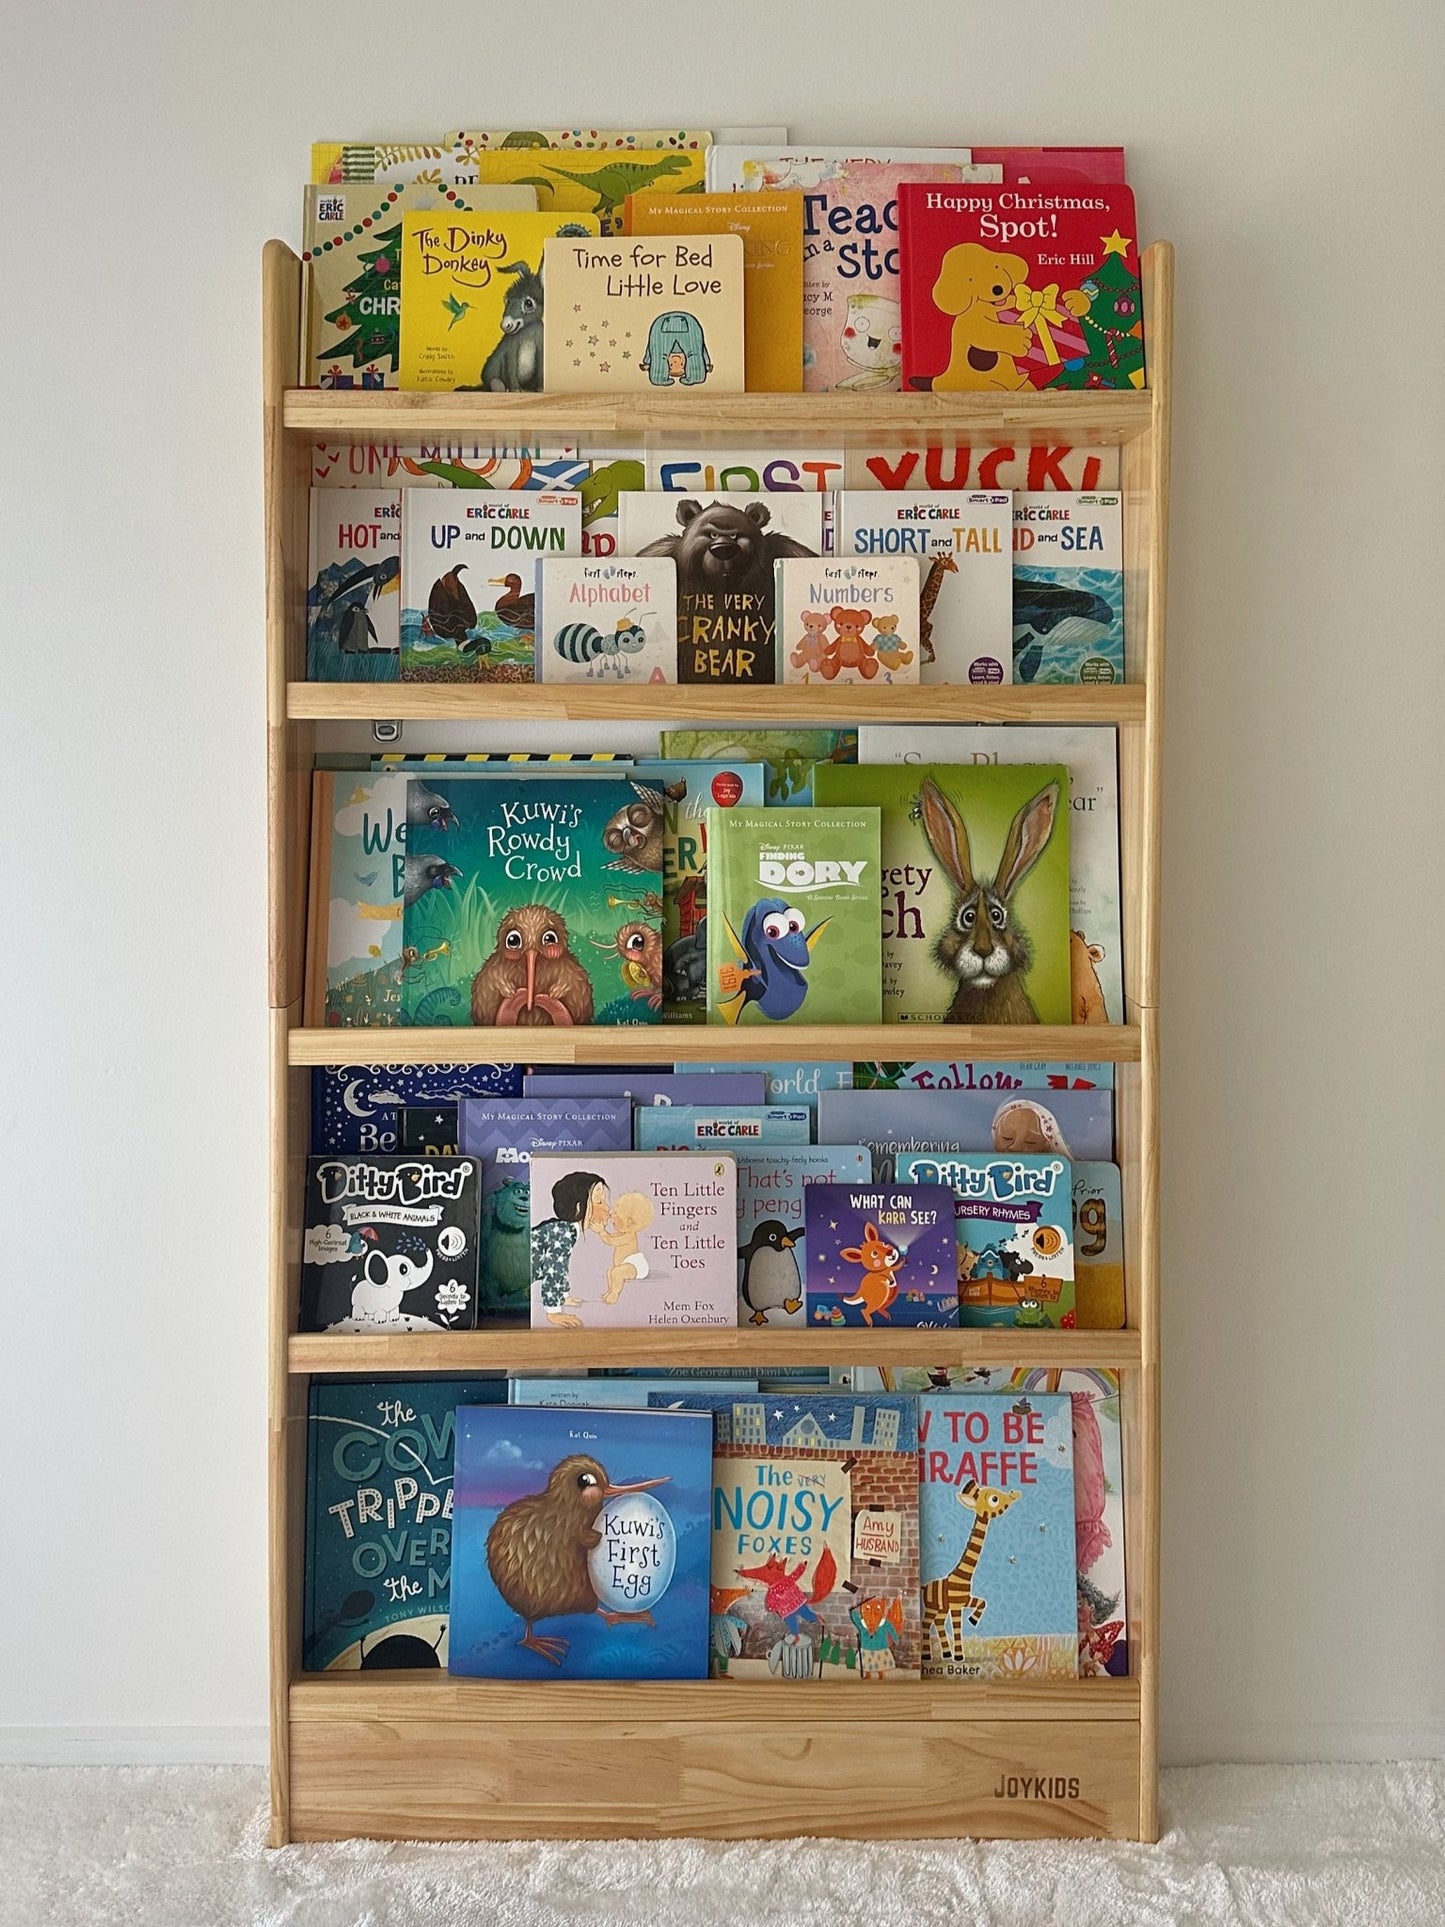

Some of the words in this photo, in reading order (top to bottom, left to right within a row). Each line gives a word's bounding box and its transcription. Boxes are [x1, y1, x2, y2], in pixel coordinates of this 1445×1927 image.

[320, 199, 343, 212] ERIC
[665, 206, 701, 214] MAGICAL
[705, 205, 731, 213] STORY
[735, 204, 787, 213] COLLECTION
[926, 193, 993, 212] Happy
[999, 193, 1110, 213] Christmas,
[319, 212, 344, 220] CARLE
[980, 214, 1058, 243] Spot!
[412, 228, 439, 253] The
[444, 227, 507, 259] Dinky
[572, 248, 622, 269] Time
[630, 244, 666, 268] for
[676, 244, 712, 268] Bed
[1038, 254, 1066, 265] Eric
[1070, 254, 1095, 265] Hill
[422, 253, 491, 288] Donkey
[607, 274, 663, 297] Little
[673, 274, 722, 295] Love
[467, 504, 496, 519] ERIC
[500, 508, 530, 519] CARLE
[898, 505, 926, 519] ERIC
[928, 508, 960, 519] CARLE
[1038, 510, 1070, 521] CARLE
[338, 524, 382, 549] HOT
[431, 525, 460, 549] UP
[465, 532, 485, 541] and
[491, 525, 565, 551] DOWN
[855, 528, 931, 554] SHORT
[931, 537, 952, 547] and
[952, 528, 1002, 553] TALL
[1038, 534, 1058, 542] and
[1061, 526, 1104, 551] SEA
[584, 567, 601, 578] first
[825, 567, 841, 578] first
[569, 582, 652, 607] Alphabet
[810, 583, 894, 604] Numbers
[683, 594, 714, 611] THE
[725, 594, 765, 611] VERY
[694, 648, 755, 678] BEAR
[500, 802, 582, 828] Kuwi's
[730, 820, 742, 828] MY
[745, 820, 782, 828] MAGICAL
[785, 820, 811, 828] STORY
[814, 820, 866, 828] COLLECTION
[487, 823, 569, 861] Rowdy
[760, 852, 805, 861] FINDING
[505, 850, 582, 882] Crowd
[760, 861, 868, 886] DORY
[767, 1068, 821, 1095] orld
[482, 1113, 495, 1121] MY
[498, 1113, 534, 1121] MAGICAL
[697, 1122, 725, 1136] ERIC
[728, 1125, 759, 1136] CARLE
[558, 1139, 583, 1147] PIXAR
[809, 1155, 829, 1163] books
[318, 1164, 395, 1202] Ditty
[396, 1164, 464, 1202] Bird
[650, 1182, 678, 1197] Ten
[685, 1181, 725, 1196] Little
[987, 1163, 1054, 1199] Bird
[850, 1194, 884, 1209] WHAT
[890, 1194, 912, 1209] CAN
[350, 1212, 371, 1220] BLACK
[379, 1212, 401, 1220] WHITE
[403, 1213, 435, 1222] ANIMALS
[661, 1202, 717, 1219] Fingers
[878, 1210, 906, 1225] KARA
[911, 1210, 937, 1225] SEE?
[993, 1207, 1030, 1220] RHYMES
[325, 1229, 331, 1239] 6
[680, 1221, 700, 1231] and
[651, 1235, 679, 1249] Ten
[685, 1234, 725, 1249] Little
[671, 1254, 706, 1269] Toes
[449, 1283, 456, 1293] 6
[664, 1301, 691, 1311] Mem
[695, 1301, 714, 1311] Fox
[649, 1314, 678, 1324] Helen
[681, 1314, 729, 1325] Oxenbury
[571, 1391, 579, 1400] by
[377, 1400, 416, 1427] the
[943, 1411, 989, 1444] TO
[1003, 1411, 1045, 1444] BE
[755, 1465, 793, 1486] The
[798, 1473, 827, 1488] VERY
[713, 1486, 844, 1532] NOISY
[604, 1513, 666, 1540] Kuwi's
[863, 1517, 894, 1537] Amy
[353, 1528, 450, 1578] OVER
[738, 1534, 812, 1555] FOXES
[856, 1538, 900, 1553] HUSBAND
[607, 1539, 660, 1568] First
[383, 1575, 423, 1602] the
[612, 1565, 651, 1599] Egg
[384, 1608, 415, 1624] TONY
[947, 1664, 980, 1675] Baker
[994, 1774, 1080, 1799] JOYKIDS
